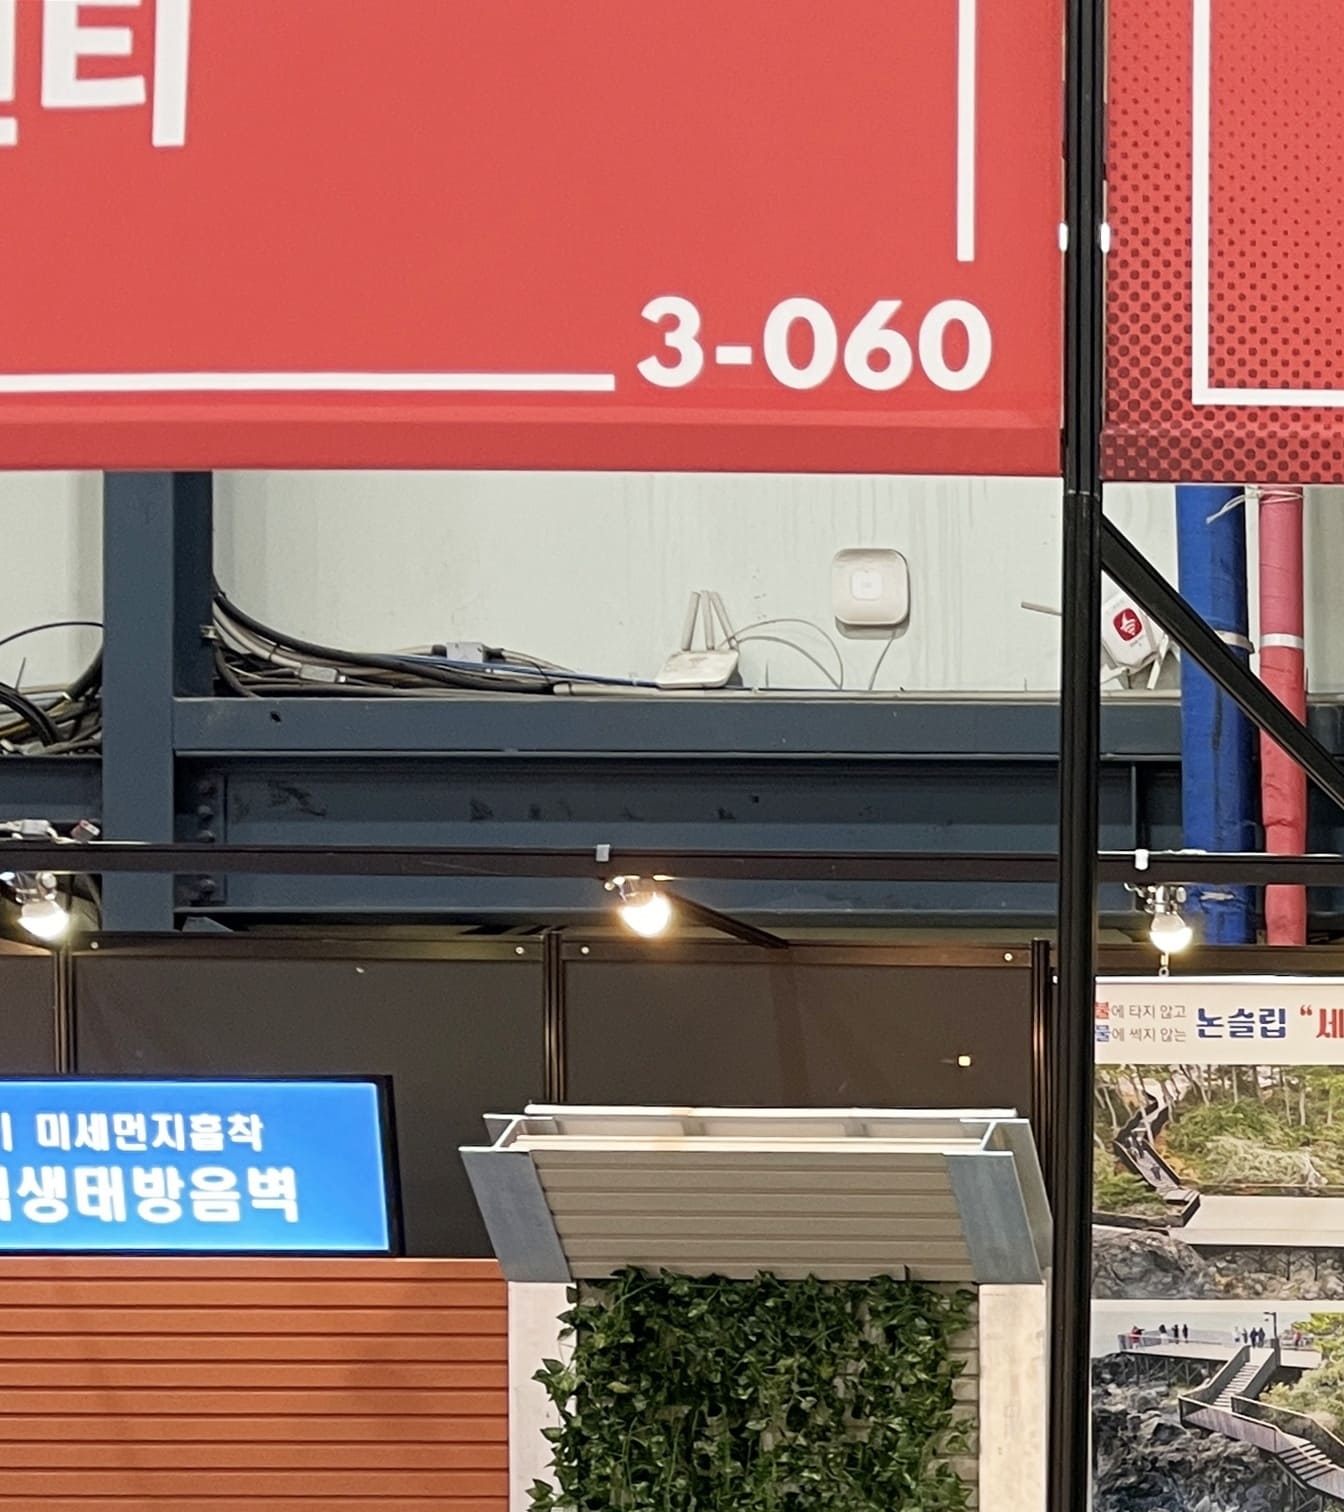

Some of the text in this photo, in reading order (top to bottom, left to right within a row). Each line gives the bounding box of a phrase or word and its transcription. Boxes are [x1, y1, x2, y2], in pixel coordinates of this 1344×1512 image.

[0, 0, 190, 147] 티
[636, 296, 994, 392] 3-060
[1129, 1005, 1156, 1019] 타지
[1196, 1007, 1287, 1039] 논슬립
[35, 1111, 264, 1152] 미세먼지흡착
[0, 1165, 300, 1224] 생태방음벽
